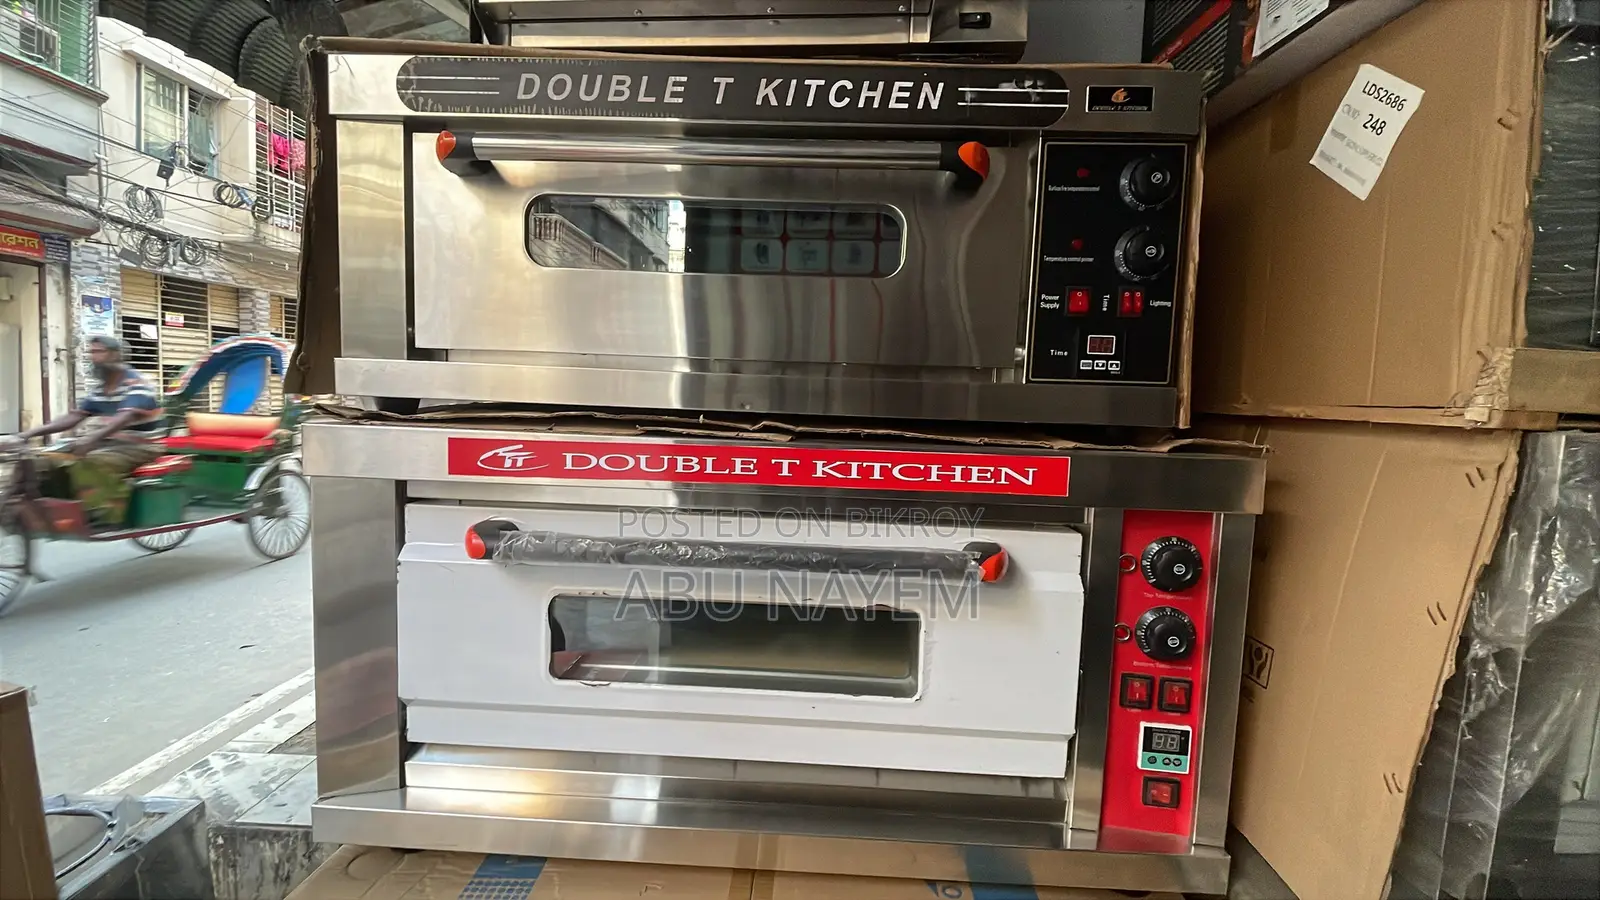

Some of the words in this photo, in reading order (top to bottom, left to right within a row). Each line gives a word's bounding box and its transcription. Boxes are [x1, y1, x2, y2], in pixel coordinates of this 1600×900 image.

[516, 73, 688, 104] DOUBLE
[713, 77, 735, 105] T
[755, 78, 945, 110] KITCHEN
[1362, 80, 1407, 112] LDS2686
[1362, 113, 1387, 136] 248
[1040, 301, 1060, 310] Supply
[1041, 293, 1060, 301] Power
[1102, 294, 1110, 312] Time
[1150, 300, 1172, 308] Lighting
[562, 452, 759, 475] DOUBLE
[771, 459, 800, 476] T
[812, 460, 1038, 486] KITCHEN
